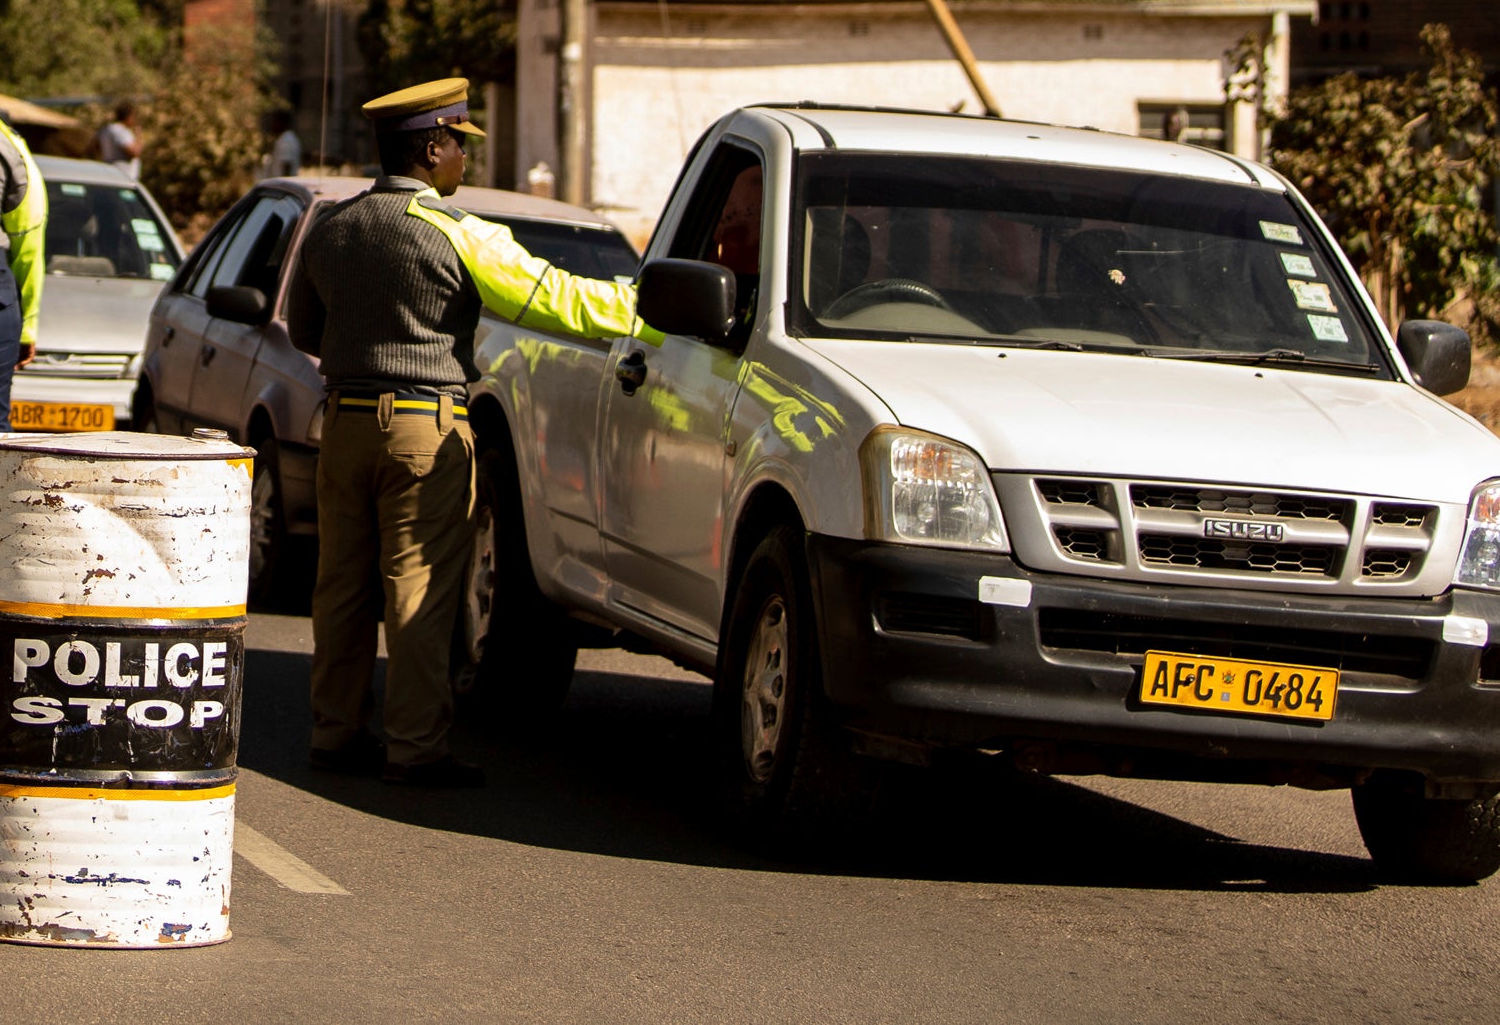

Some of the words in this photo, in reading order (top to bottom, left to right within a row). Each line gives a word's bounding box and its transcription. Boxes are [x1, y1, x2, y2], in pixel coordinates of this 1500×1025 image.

[10, 405, 44, 424] ABR
[58, 406, 104, 427] 1700
[1206, 521, 1282, 541] ISUZU
[13, 638, 227, 688] POLICE
[1150, 660, 1215, 701] AFC
[1243, 669, 1323, 712] 0484
[10, 696, 224, 728] STOP
